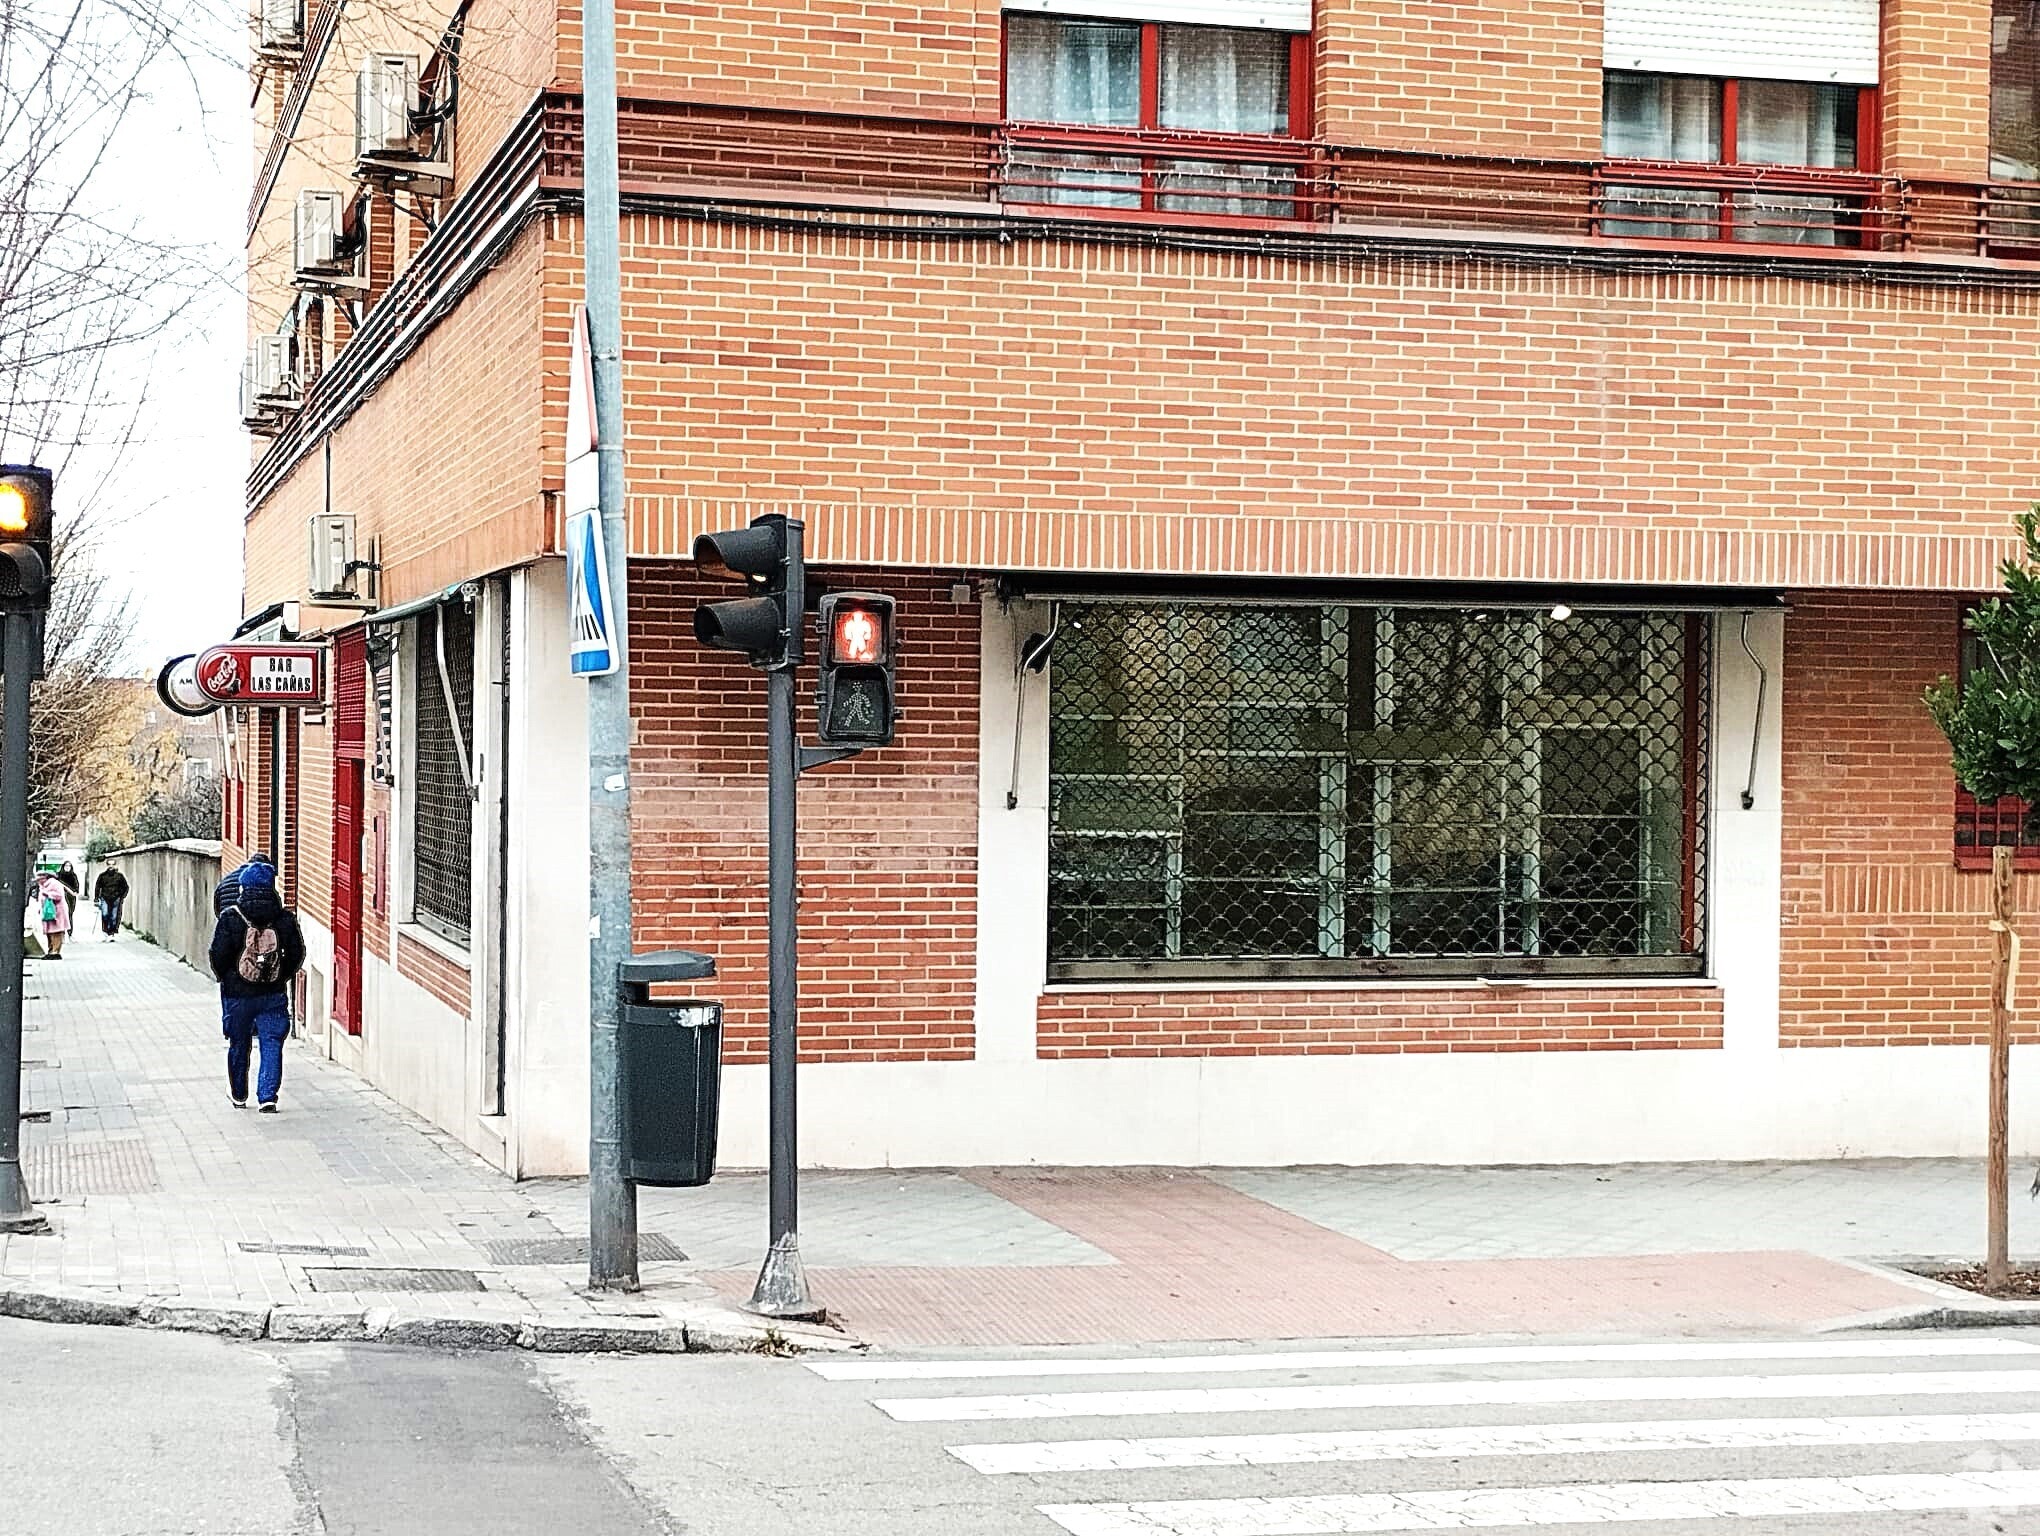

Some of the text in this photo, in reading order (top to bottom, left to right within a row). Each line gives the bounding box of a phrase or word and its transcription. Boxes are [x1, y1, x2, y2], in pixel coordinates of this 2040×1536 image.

[269, 658, 292, 673] BAR
[252, 674, 311, 692] LAS CAÑAS
